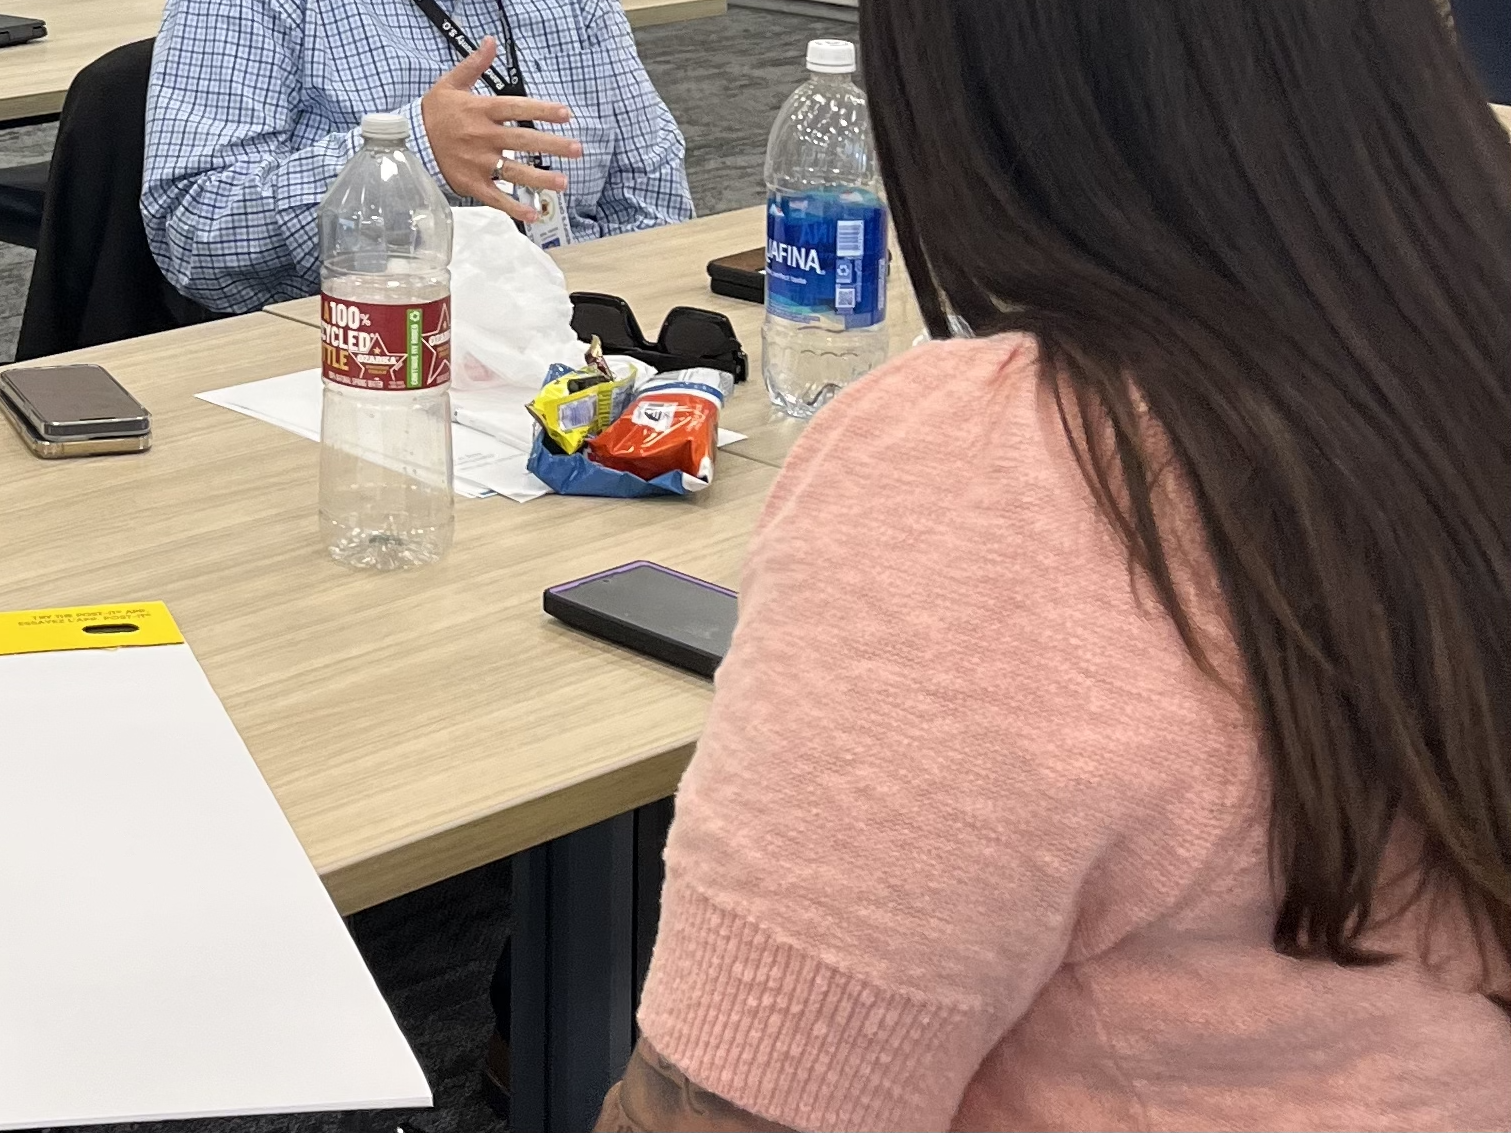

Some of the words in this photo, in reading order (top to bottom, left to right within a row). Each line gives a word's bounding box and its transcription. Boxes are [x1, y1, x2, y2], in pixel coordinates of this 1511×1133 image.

[442, 19, 458, 37] S.O.
[486, 68, 505, 90] Rand
[329, 301, 371, 329] 100%
[323, 344, 349, 371] TTLE
